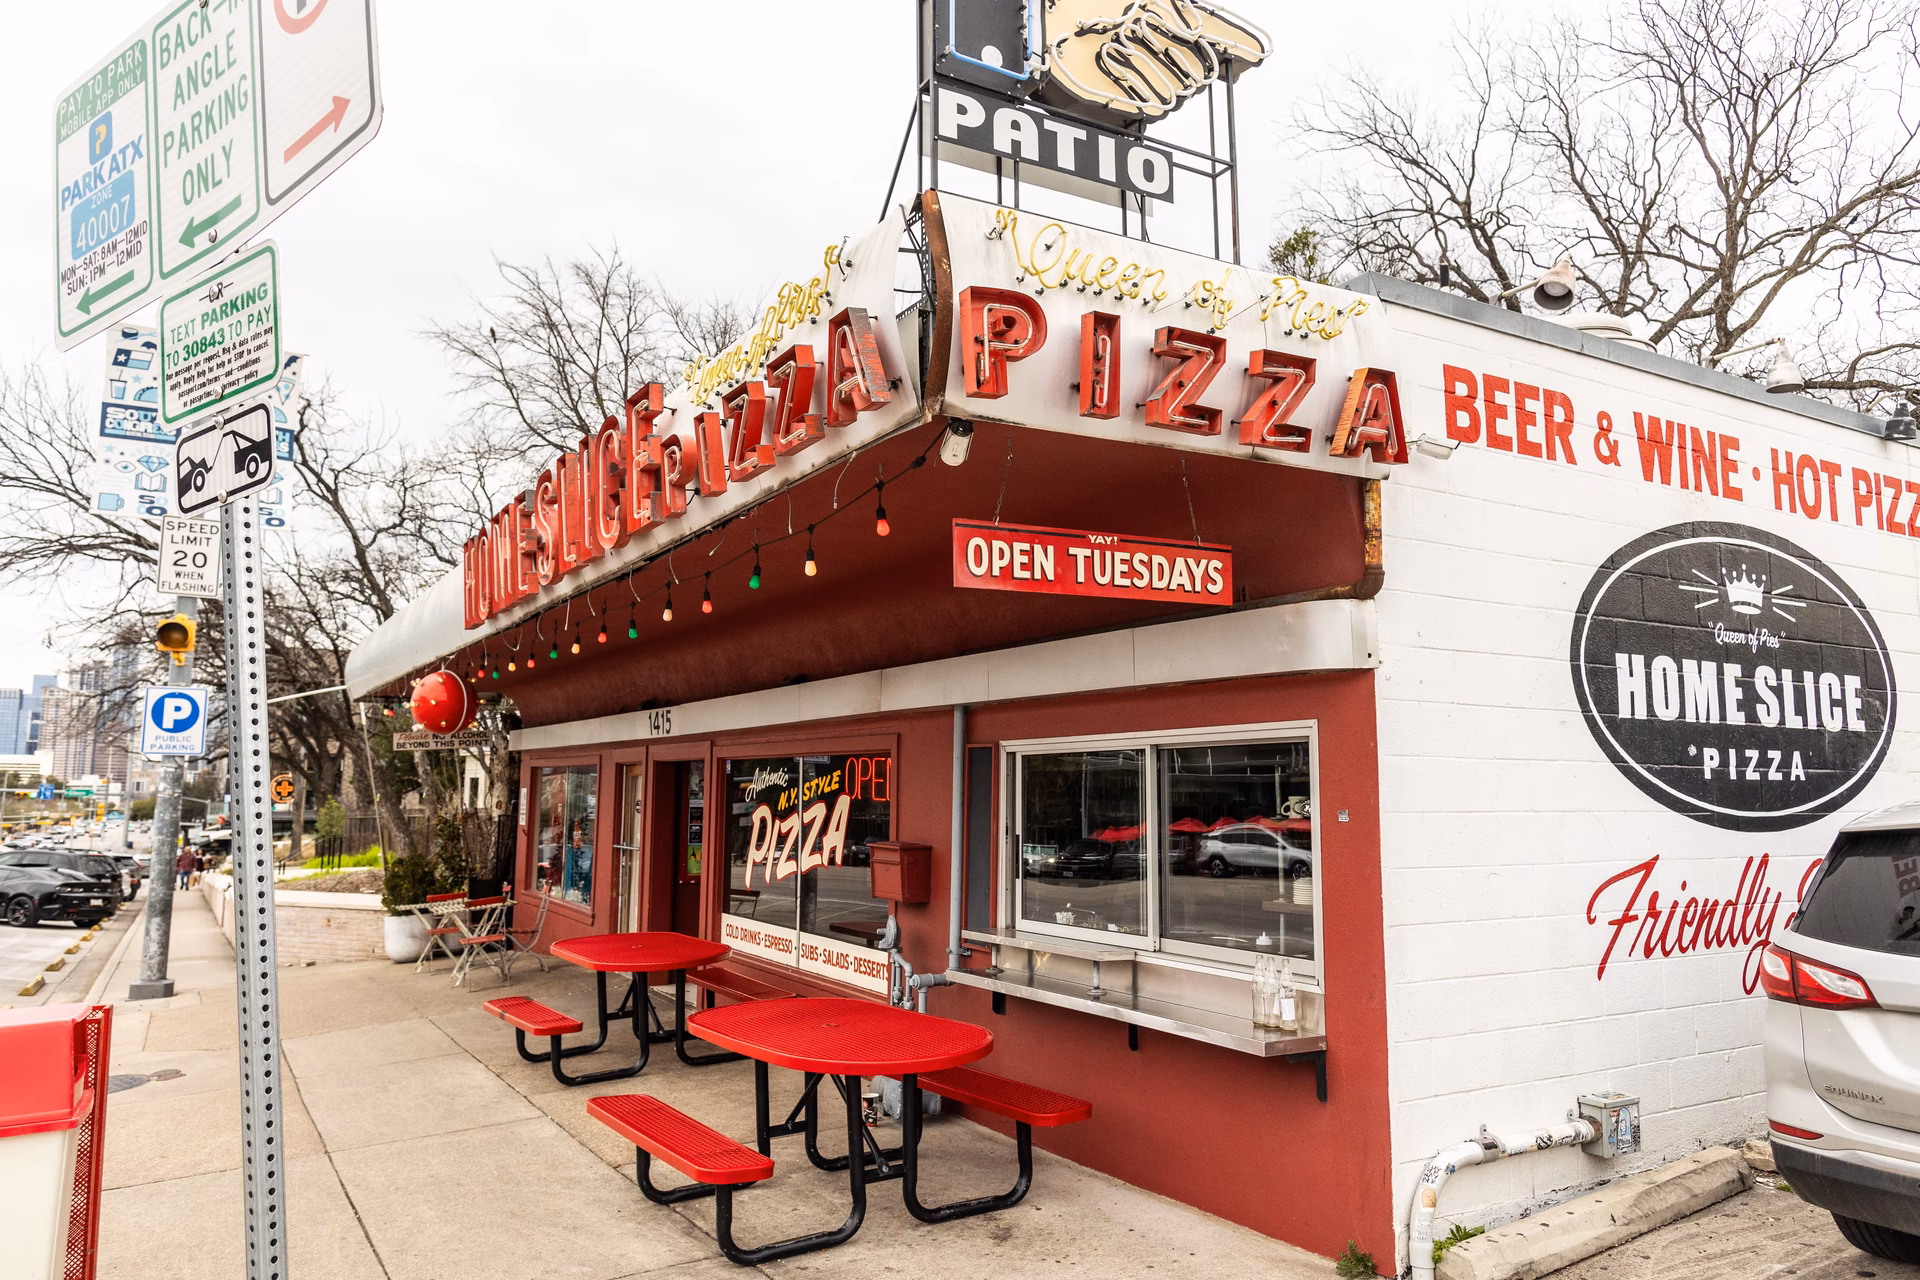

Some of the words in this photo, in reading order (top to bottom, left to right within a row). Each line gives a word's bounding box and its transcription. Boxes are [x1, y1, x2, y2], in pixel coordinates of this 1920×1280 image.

[160, 0, 244, 70] BACK-
[60, 88, 83, 123] PAY
[88, 74, 102, 100] TO
[108, 41, 142, 86] PARK
[174, 28, 237, 111] ANGLE
[60, 105, 92, 140] MOBILE
[96, 88, 113, 114] APP
[118, 66, 141, 97] ONLY
[164, 73, 248, 168] PARKING
[938, 87, 1170, 196] PATIO
[183, 138, 233, 205] ONLY
[92, 184, 113, 209] ZONE
[76, 194, 130, 251] 40007
[67, 275, 88, 296] SUN:
[1195, 268, 1234, 330] of
[170, 318, 196, 345] TEXT
[201, 282, 268, 330] PARKING
[166, 350, 180, 369] TO
[183, 327, 225, 361] 30843
[228, 319, 242, 340] TO
[248, 304, 271, 331] PAY
[166, 371, 174, 381] One
[175, 364, 193, 378] message
[222, 345, 231, 357] Msg
[232, 341, 237, 351] &
[239, 337, 249, 348] data
[250, 331, 262, 342] rates
[264, 325, 273, 337] may
[183, 372, 195, 385] Reply
[197, 367, 206, 379] Help
[216, 359, 225, 371] help
[227, 356, 233, 365] or
[234, 349, 245, 362] STOP
[246, 347, 252, 356] to
[959, 285, 1408, 463] PIZZA
[183, 400, 188, 408] or
[1442, 363, 1578, 466] BEER
[1593, 410, 1621, 468] &
[1632, 411, 1743, 502] WINE
[1771, 447, 1842, 522] HOT
[464, 489, 539, 630] HOME
[534, 381, 665, 586] SLICE
[660, 308, 891, 518] PIZZA
[166, 520, 219, 535] SPEED
[171, 534, 212, 547] LIMIT
[1088, 533, 1118, 545] YAY!
[172, 550, 208, 568] 20
[175, 570, 204, 580] WHEN
[967, 537, 1054, 581] OPEN
[1068, 546, 1224, 594] TUESDAYS
[161, 580, 214, 593] FLASHING
[1748, 627, 1759, 653] of
[1614, 652, 1746, 726] HOME
[1754, 664, 1866, 732] SLICE
[155, 735, 191, 743] PUBLIC
[396, 741, 430, 749] BEYOND
[433, 740, 455, 748] THIS
[458, 738, 490, 747] POINT
[450, 731, 490, 740] ALCOHOL
[648, 709, 672, 736] 1415
[150, 743, 195, 752] PARKING
[1702, 747, 1806, 781] PIZZA
[745, 766, 789, 802] Authentic
[778, 786, 798, 811] N.Y.
[803, 770, 841, 801] STYLE
[744, 791, 851, 891] PIZZA
[1586, 852, 1782, 995] Friendly
[726, 923, 738, 940] COLD
[740, 927, 762, 946] DRINKS
[764, 934, 793, 955] ESPRESSO
[801, 943, 819, 962] SUBS
[822, 948, 850, 970] SALADS
[1824, 1084, 1885, 1105] EQUINOX
